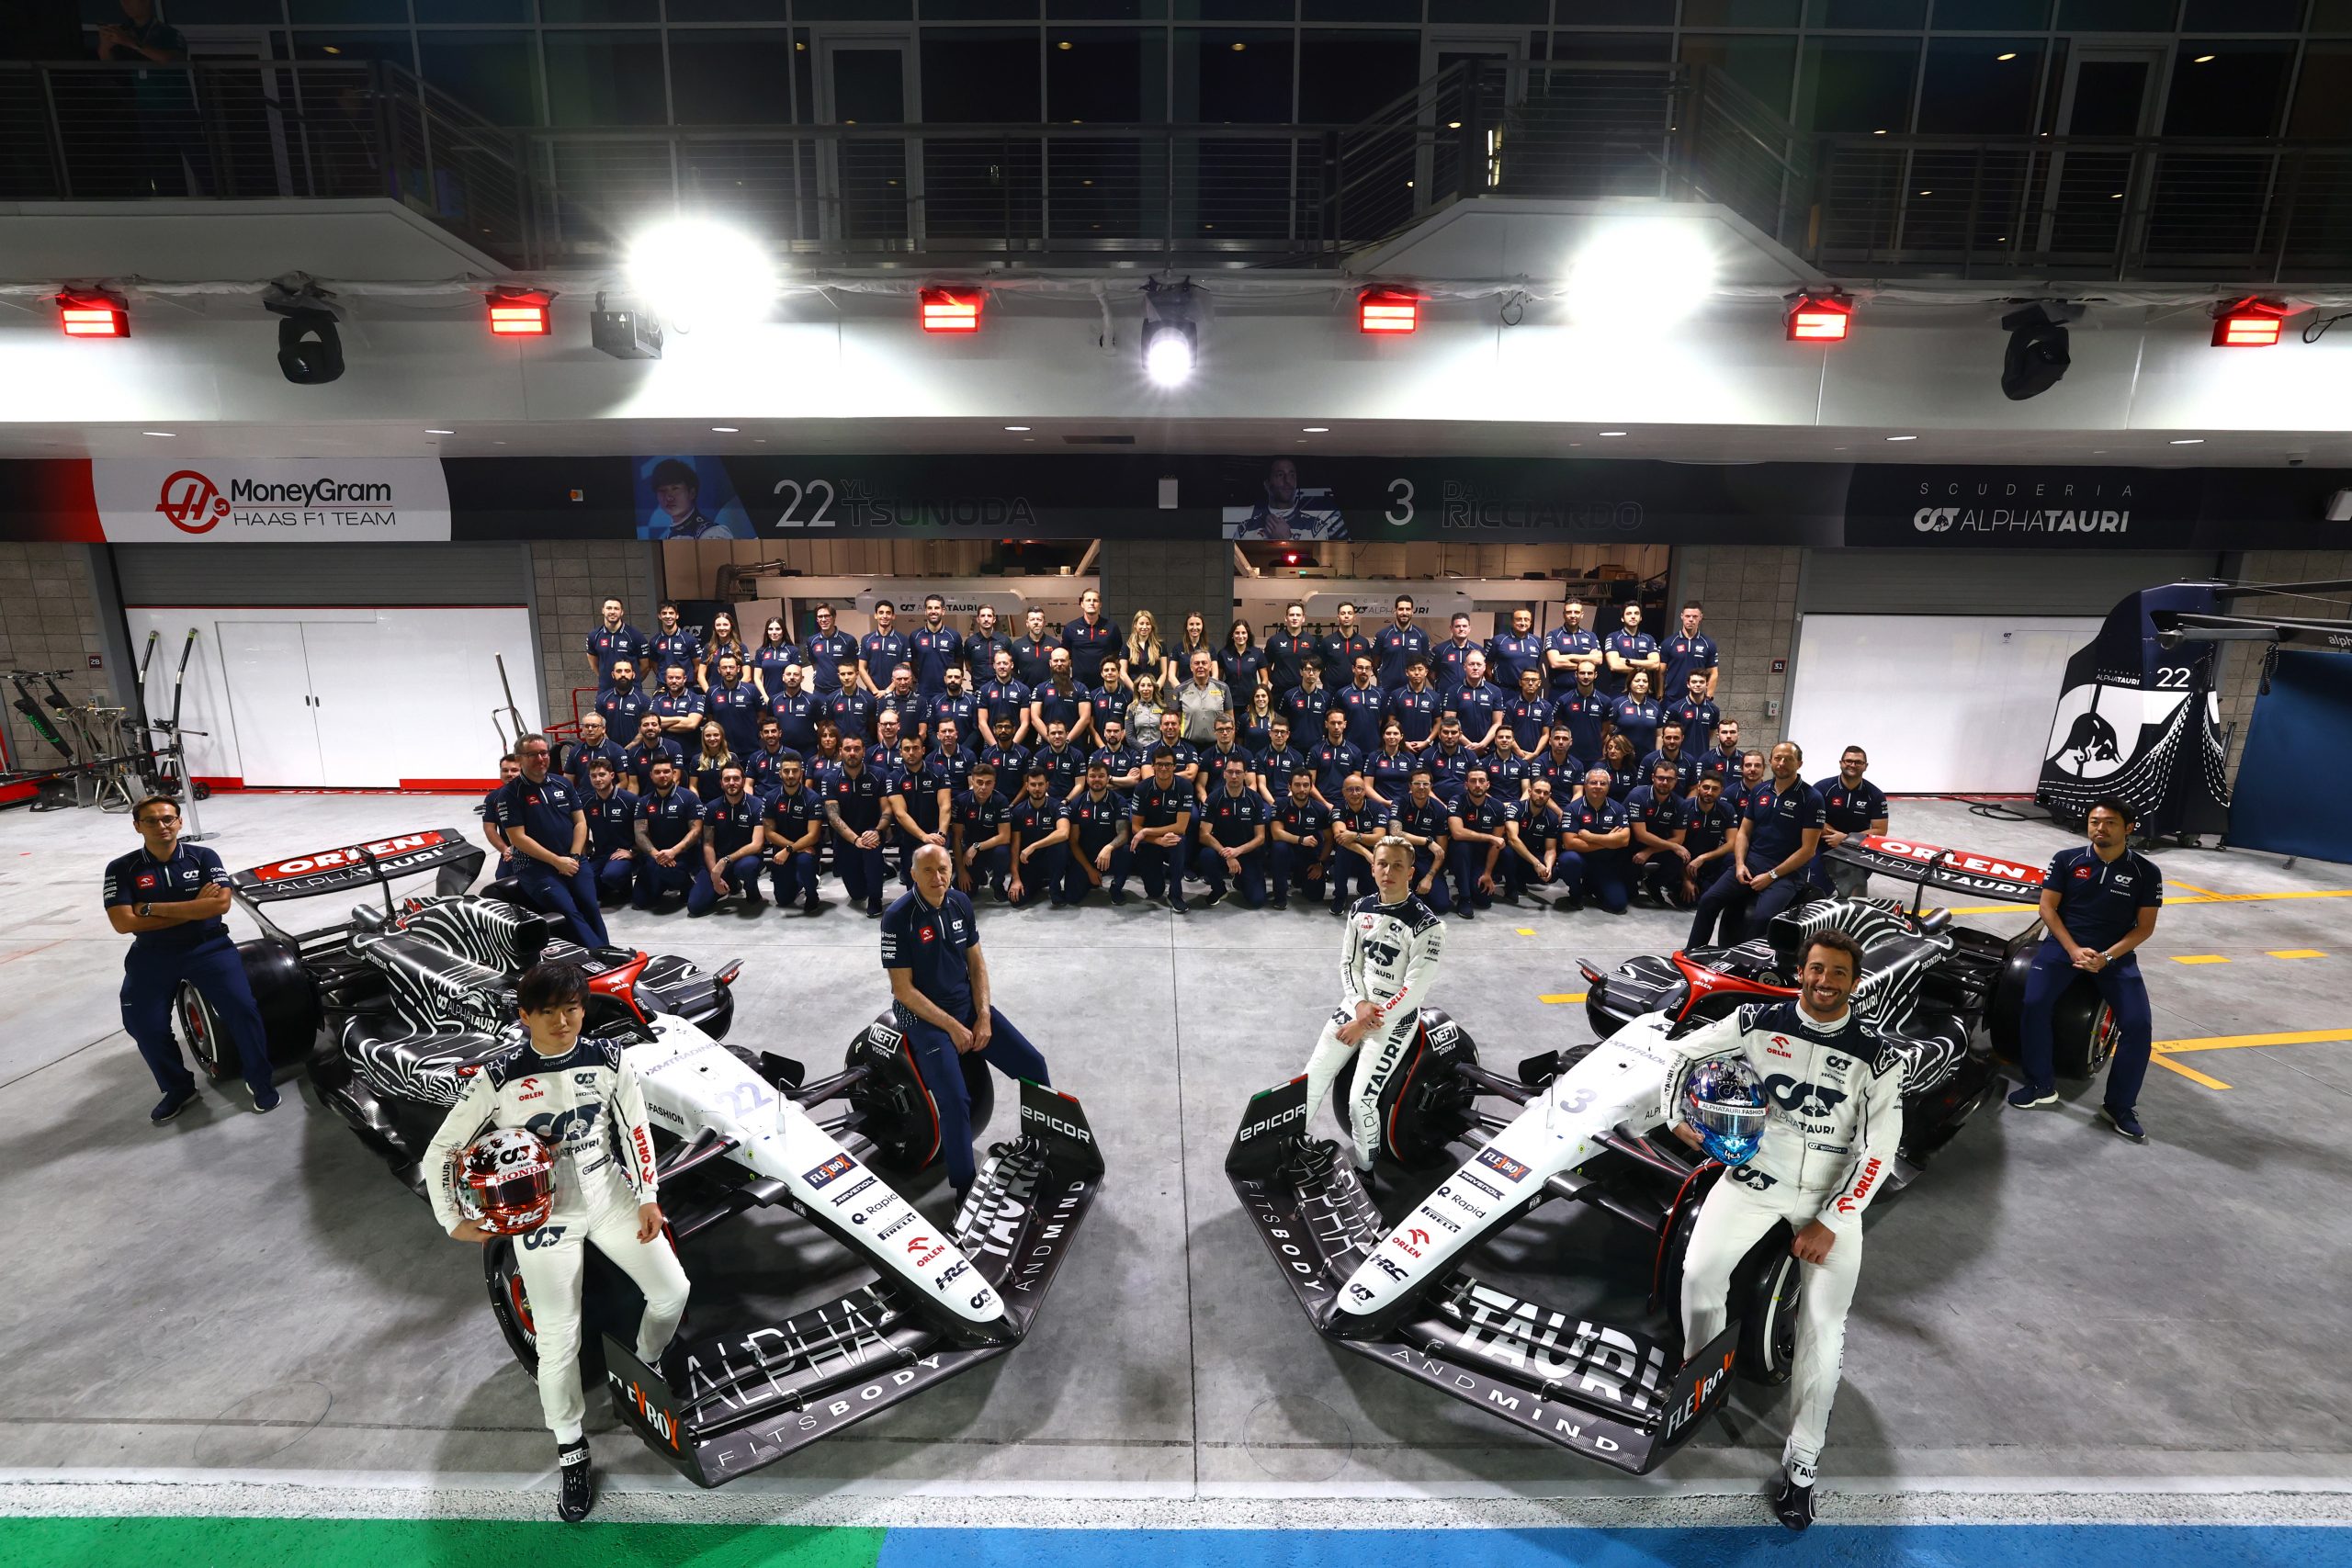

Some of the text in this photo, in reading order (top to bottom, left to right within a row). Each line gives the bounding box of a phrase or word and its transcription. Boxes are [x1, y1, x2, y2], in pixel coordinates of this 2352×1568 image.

[231, 478, 391, 508] MoneyGram
[1385, 478, 1415, 526] 3
[1919, 482, 2132, 497] SCUDERIA
[773, 479, 837, 528] 22
[841, 497, 1036, 528] TSUNODA
[1442, 499, 1643, 531] RICCIARDO
[232, 512, 396, 526] HAAS F1 TEAM
[1960, 509, 2130, 533] ALPHATAURI
[2155, 667, 2191, 688] 22
[1881, 841, 2027, 880] ORLEN
[366, 950, 390, 973] HONDA
[1920, 953, 1943, 972] HONDA
[1385, 986, 1408, 1010] ORLEN
[447, 1000, 503, 1035] ALPHATAURI
[871, 1027, 897, 1047] NEFT
[1433, 1023, 1458, 1044] NEFT
[1766, 1047, 1792, 1058] ORLEN
[1820, 1072, 1846, 1085] HOND
[518, 1090, 544, 1101] ORLEN
[715, 1082, 774, 1120] 22
[1559, 1088, 1598, 1114] 3
[633, 1125, 651, 1164] ORLEN
[495, 1165, 548, 1183] HONDA
[808, 1155, 852, 1184] FLEXBOX
[1483, 1151, 1526, 1179] FLEXBOX
[1853, 1157, 1882, 1199] ORLEN
[834, 1177, 876, 1204] RAVENOL
[1462, 1171, 1502, 1198] RAVENOL
[506, 1205, 544, 1226] HRC
[865, 1193, 899, 1215] Rapid
[1451, 1194, 1487, 1219] Rapid
[876, 1213, 917, 1241] PIRELLI
[1419, 1205, 1462, 1234] PIRELLI
[1241, 1179, 1326, 1292] FITSBODY
[1392, 1236, 1427, 1258] ORLEN
[916, 1245, 945, 1267] ORLEN
[1369, 1254, 1410, 1281] HRC
[934, 1259, 970, 1291] HRC
[686, 1298, 899, 1424] ALPHA
[1455, 1284, 1666, 1411] TAURI
[718, 1355, 941, 1468] FITSBODY
[1792, 1461, 1817, 1480] TAU
